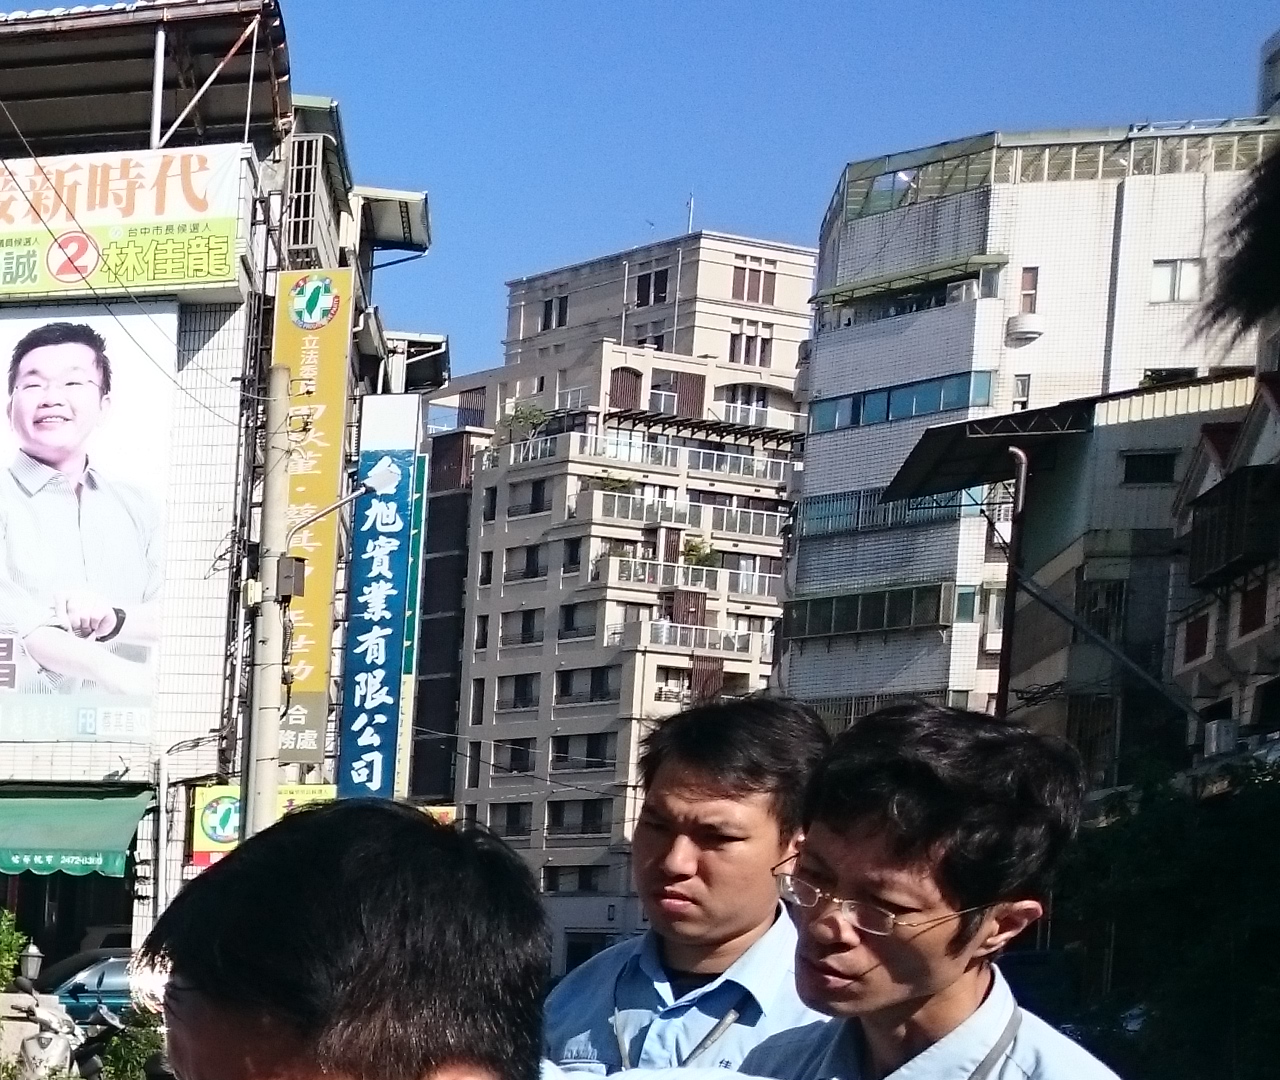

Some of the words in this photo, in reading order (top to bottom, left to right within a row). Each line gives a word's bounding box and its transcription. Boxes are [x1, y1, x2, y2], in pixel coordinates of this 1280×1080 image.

[128, 223, 212, 237] 台中市長候選人
[55, 235, 90, 276] 2
[100, 235, 231, 283] 林佳龍
[79, 708, 96, 733] FB
